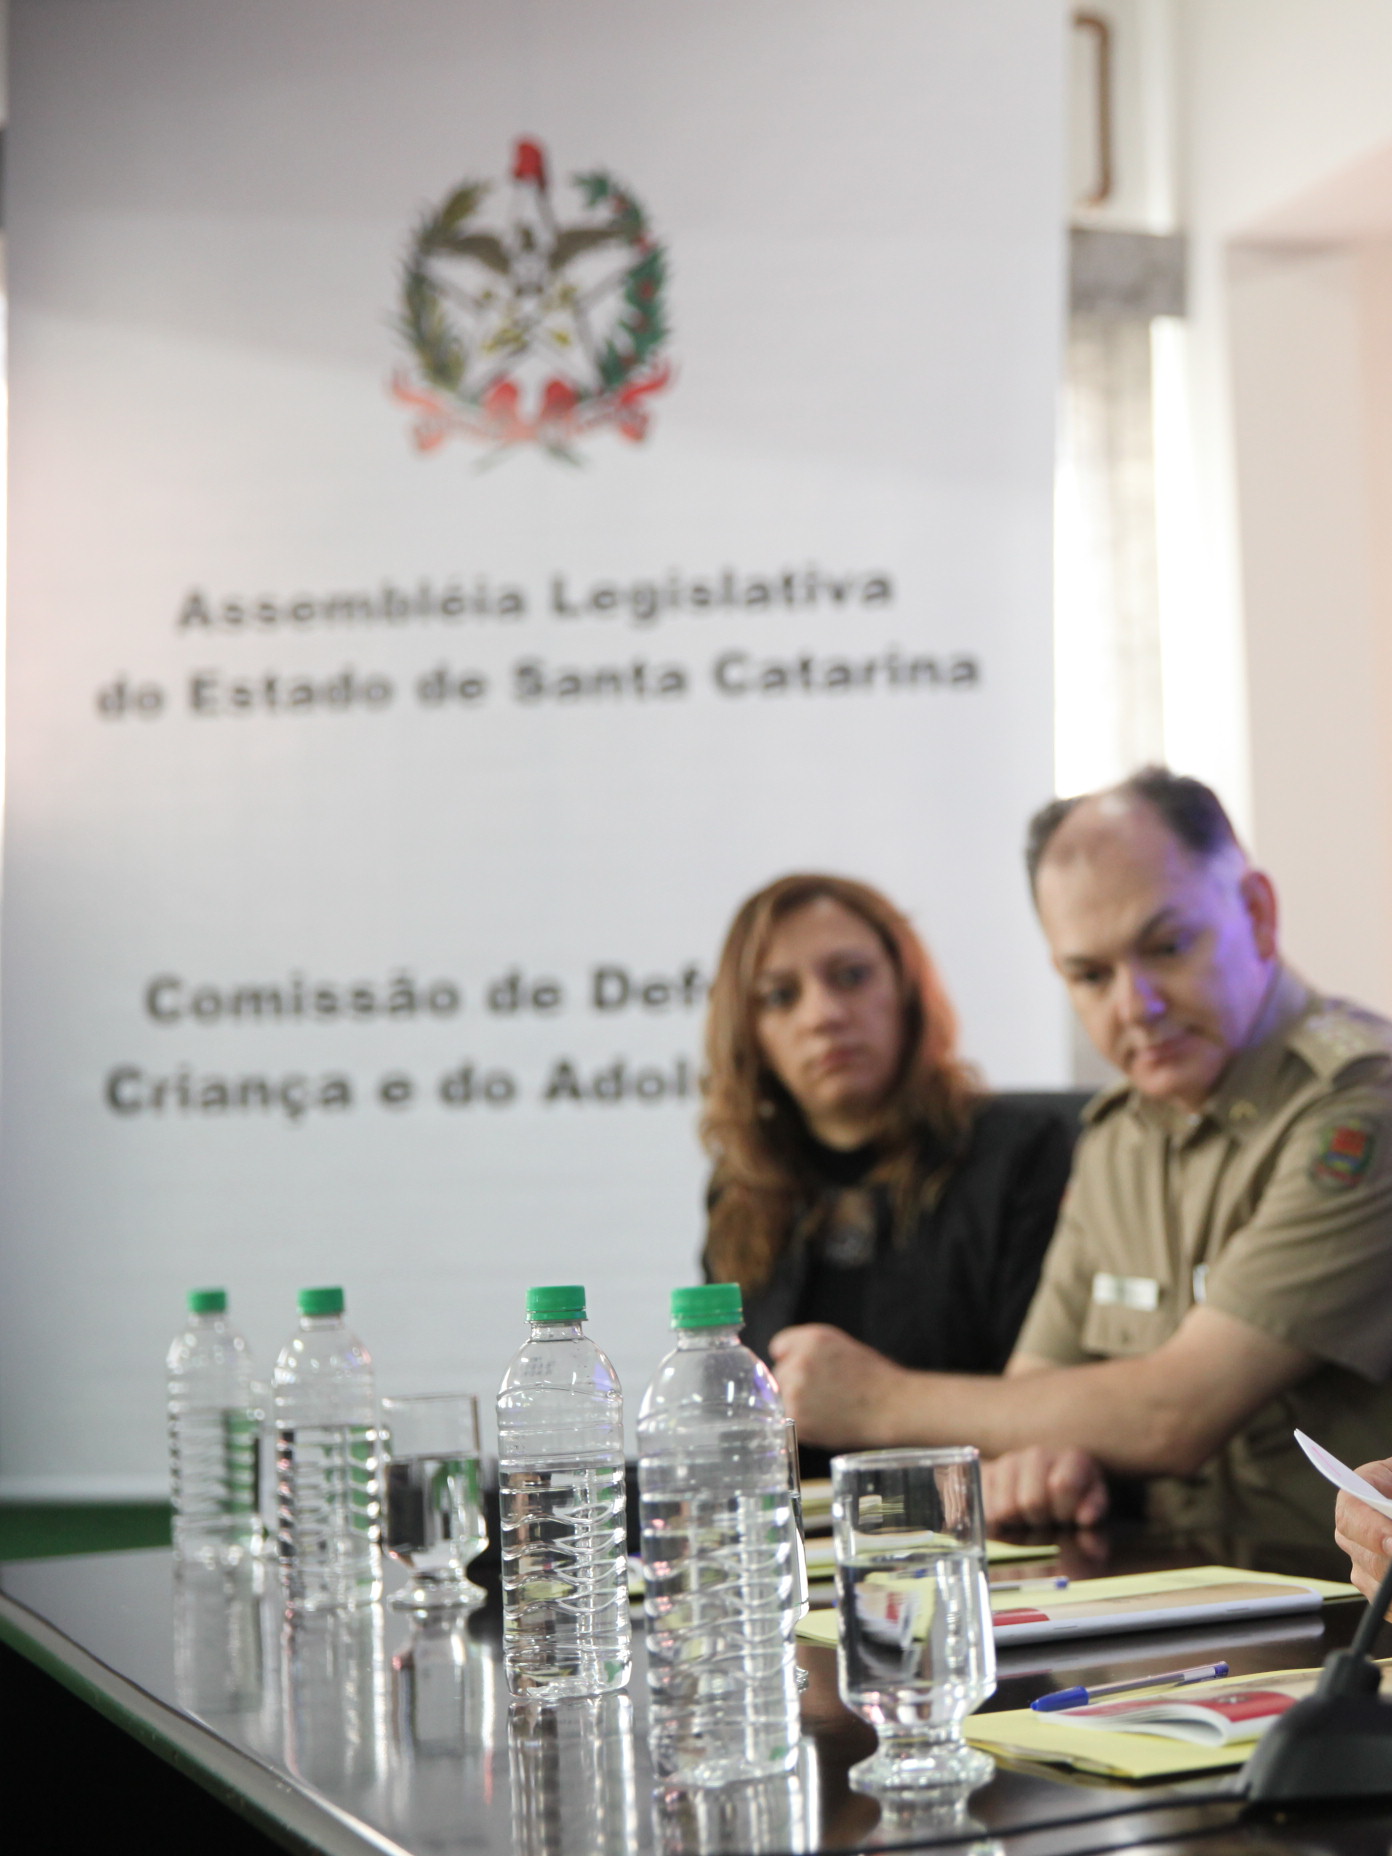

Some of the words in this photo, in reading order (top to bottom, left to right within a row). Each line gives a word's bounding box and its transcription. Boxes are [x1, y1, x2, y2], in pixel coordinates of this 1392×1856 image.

[176, 579, 528, 632] Assembléia
[550, 569, 895, 626] Legislativa
[95, 676, 166, 719] do
[187, 669, 395, 717] Estado
[415, 665, 488, 707] de
[512, 658, 690, 704] Santa
[710, 649, 982, 699] Catarina
[143, 970, 463, 1026] Comissão
[484, 967, 564, 1017] de
[103, 1063, 355, 1123] Criança
[375, 1073, 416, 1110] e
[436, 1060, 519, 1109] do
